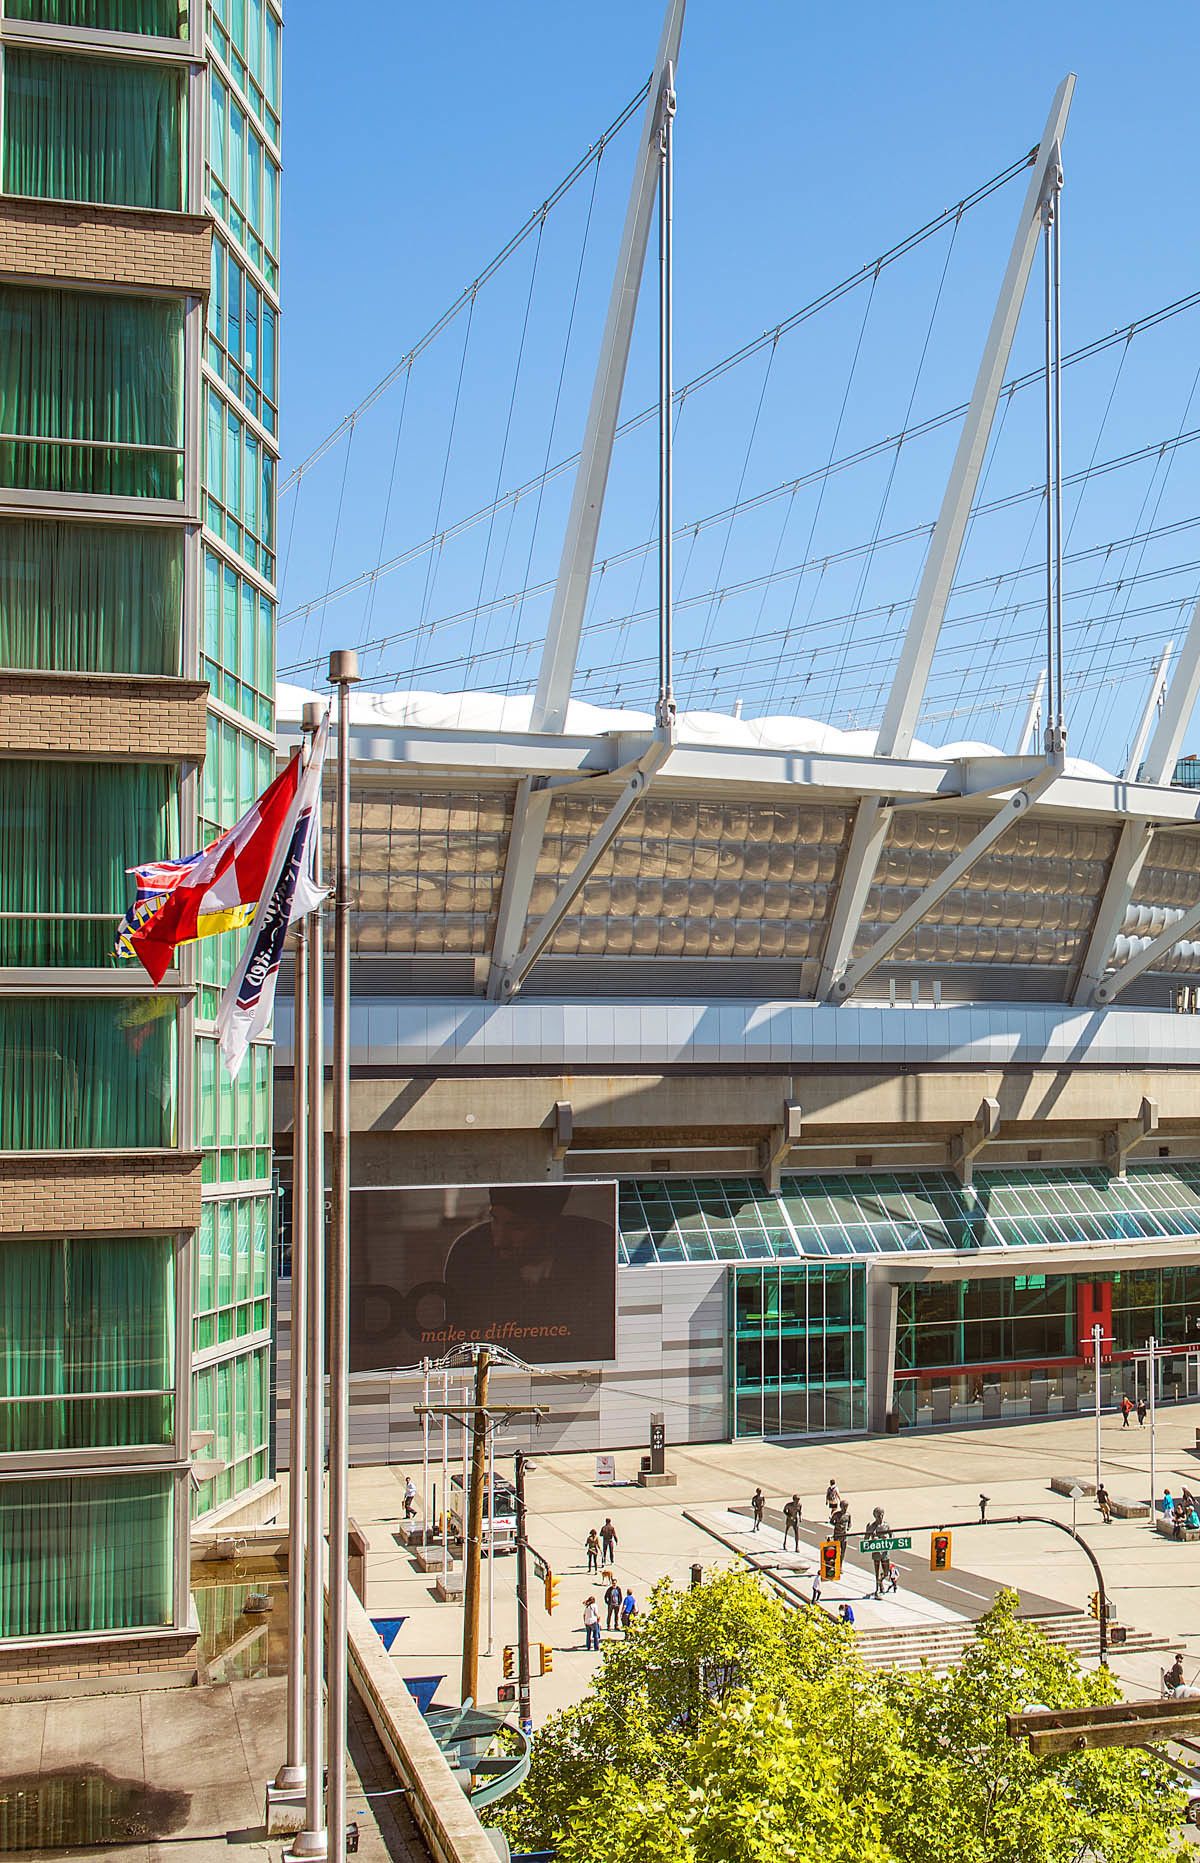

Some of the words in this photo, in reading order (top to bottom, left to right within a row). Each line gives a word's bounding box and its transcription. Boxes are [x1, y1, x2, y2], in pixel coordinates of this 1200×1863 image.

[420, 1325, 466, 1342] make
[470, 1330, 481, 1341] a
[484, 1322, 572, 1341] difference.
[863, 1540, 894, 1551] Beatty
[898, 1539, 909, 1548] St
